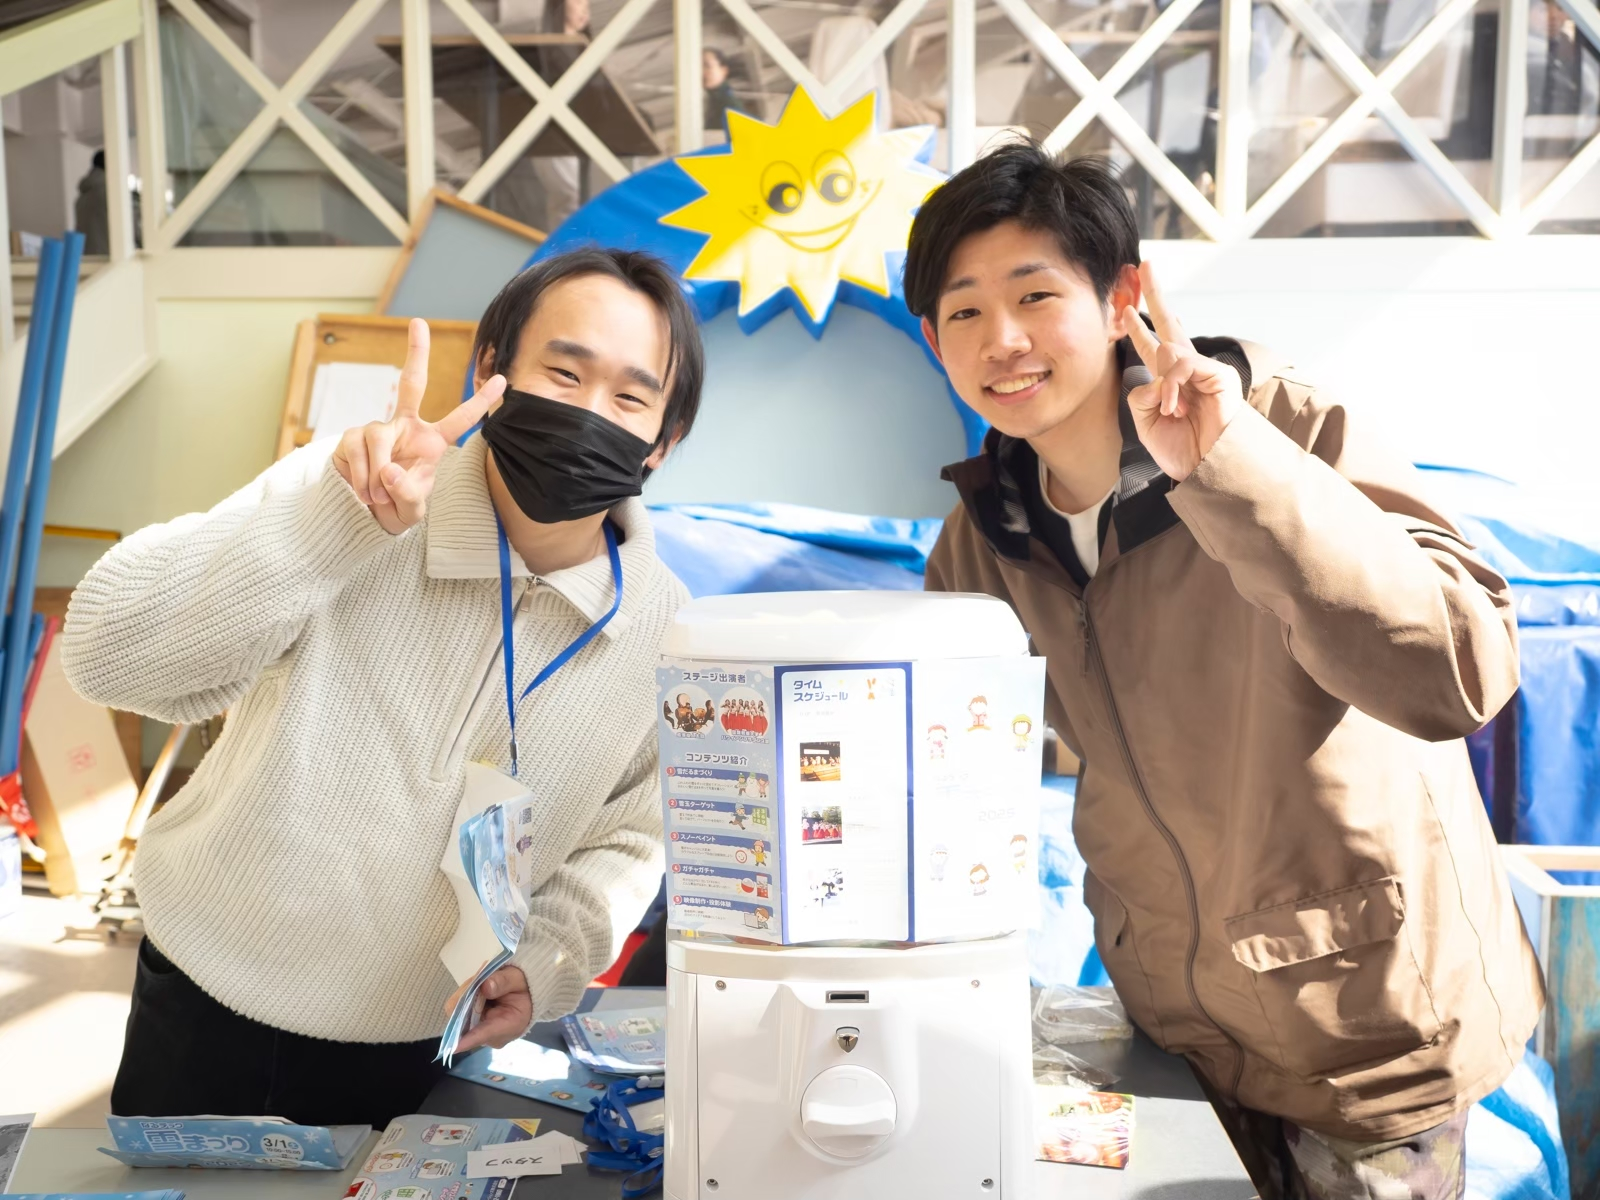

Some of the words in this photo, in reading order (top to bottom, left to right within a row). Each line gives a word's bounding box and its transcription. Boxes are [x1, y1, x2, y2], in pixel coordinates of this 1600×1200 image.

[683, 672, 746, 683] ステージ出演者
[793, 680, 822, 690] タイム
[793, 692, 849, 702] スケジュール
[686, 753, 748, 765] コンテンツ紹介
[677, 768, 713, 776] 雪だるまづくり
[678, 800, 716, 809] 雪玉ターゲット
[682, 865, 715, 873] ガチャガチャ
[145, 1130, 249, 1152] 雪まつり
[263, 1137, 287, 1148] 3/1
[485, 1156, 543, 1167] スタッフ
